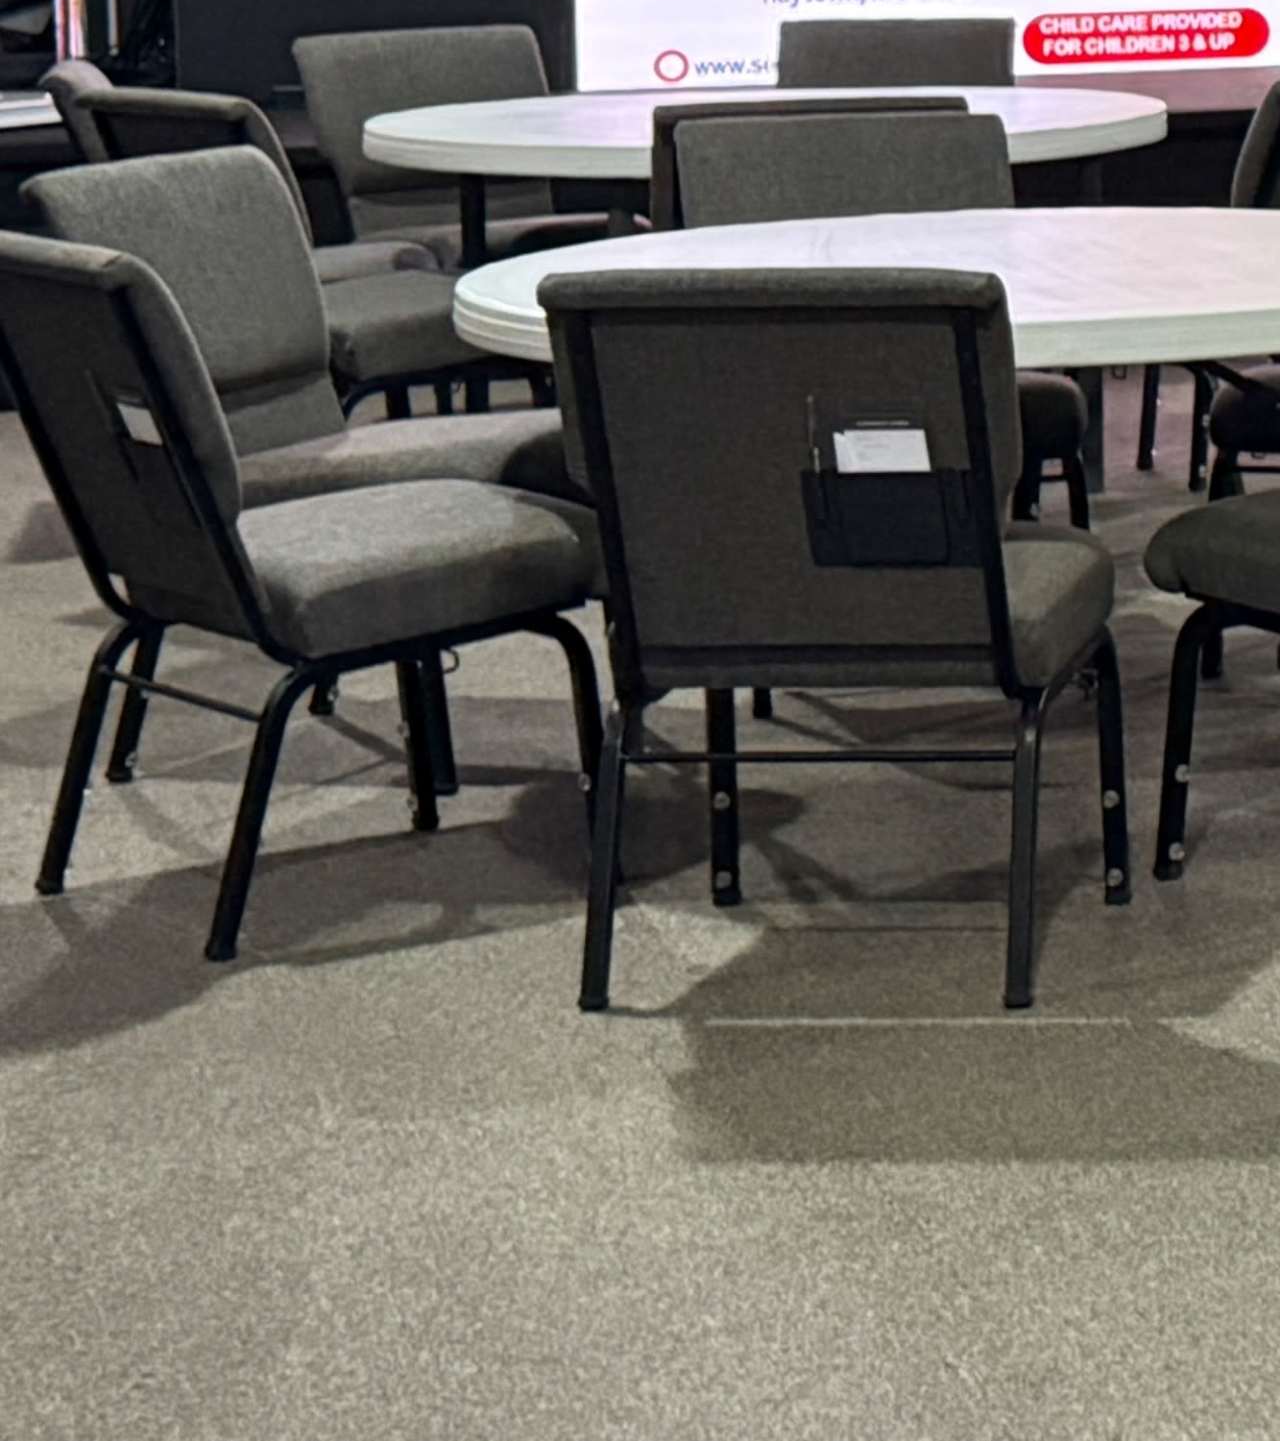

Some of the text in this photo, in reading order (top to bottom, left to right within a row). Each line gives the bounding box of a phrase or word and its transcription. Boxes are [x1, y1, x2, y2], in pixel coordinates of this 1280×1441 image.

[1040, 11, 1243, 35] CHILD CARE PROVIDED
[1043, 37, 1083, 57] FOR
[1084, 33, 1176, 54] CHILDREN
[1178, 33, 1190, 52] 3
[1209, 31, 1236, 51] UP
